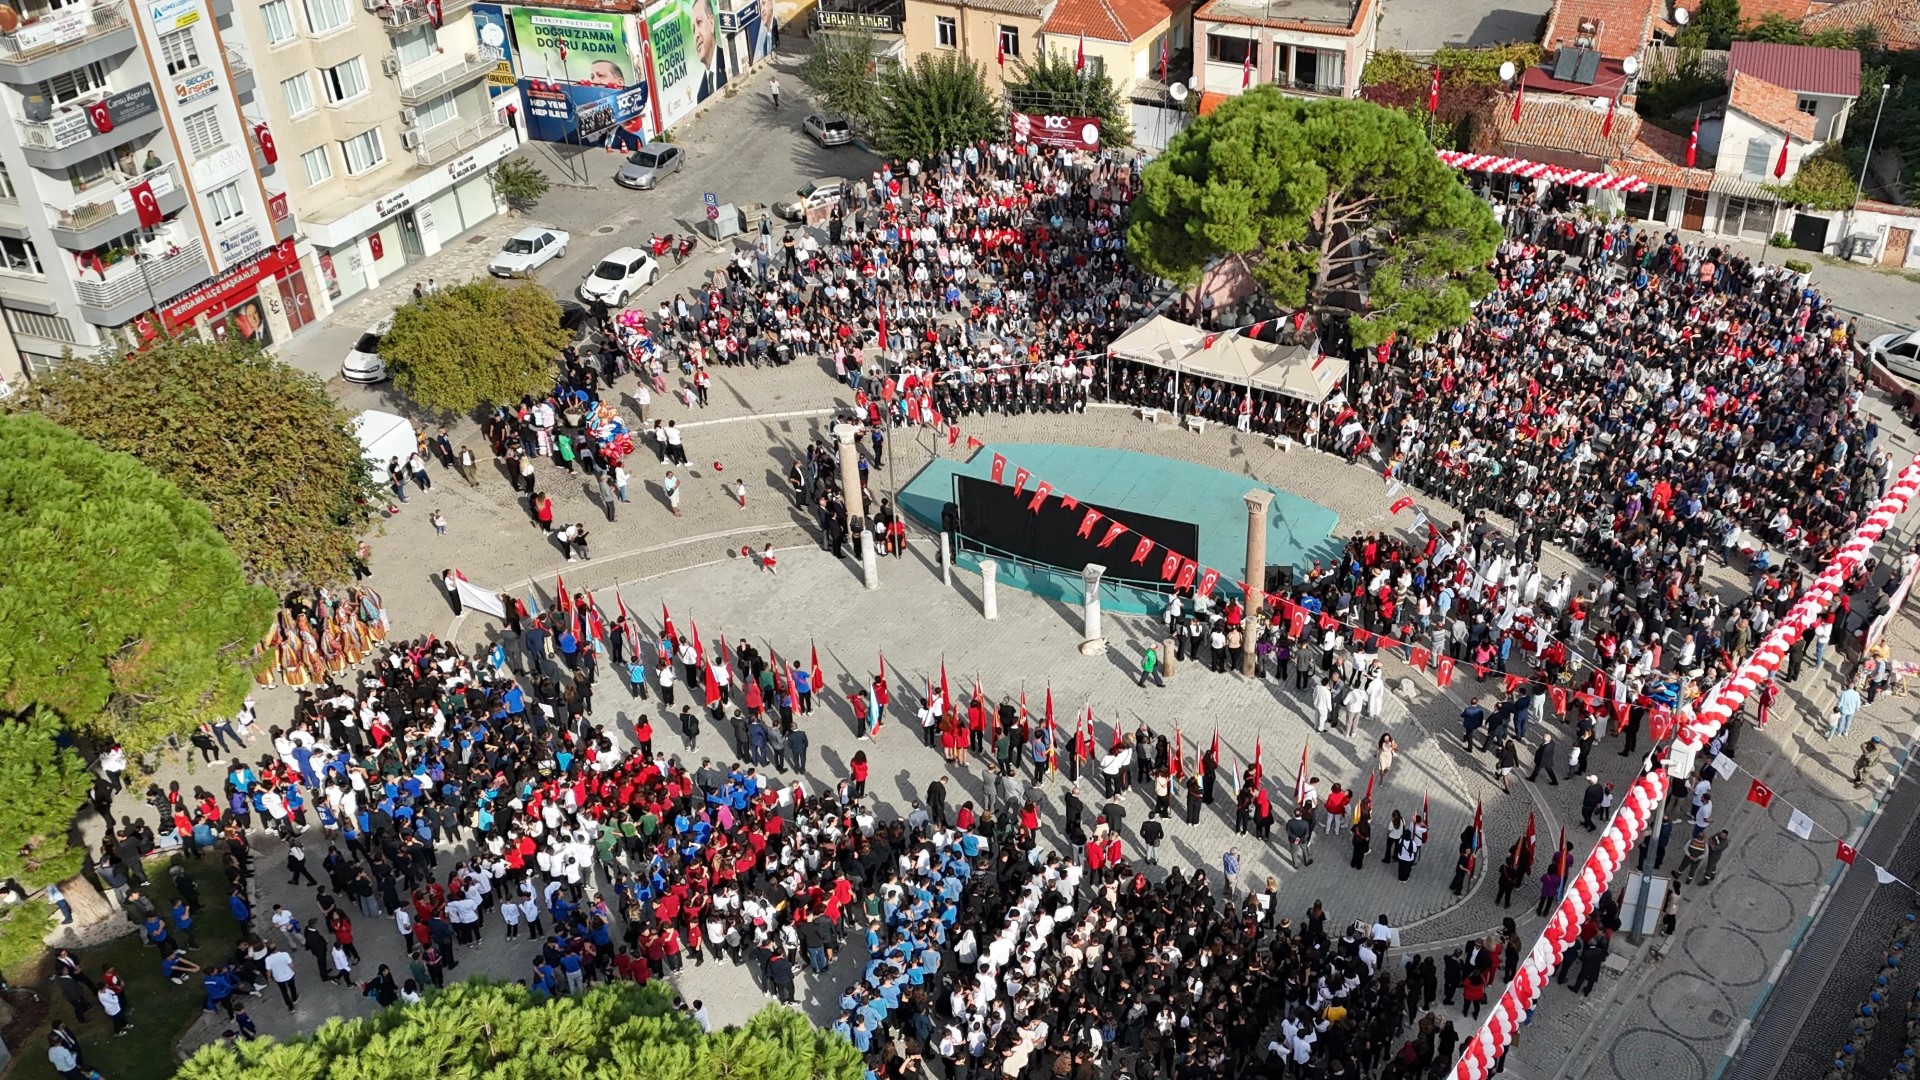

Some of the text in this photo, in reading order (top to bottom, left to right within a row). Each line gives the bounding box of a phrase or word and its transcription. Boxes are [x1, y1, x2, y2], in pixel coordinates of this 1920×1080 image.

[535, 25, 614, 42] DOĞRU ZAMAN
[653, 19, 681, 46] DOĞRU
[581, 41, 617, 54] ADAM
[656, 33, 683, 60] ZAMAN
[658, 48, 686, 76] DOĞRU
[662, 61, 688, 92] ADAM
[106, 96, 126, 110] Cansu
[126, 87, 150, 102] Köprülü
[530, 99, 547, 108] HEP
[531, 108, 549, 117] HEP
[241, 249, 272, 271] PARTİSİ
[172, 295, 207, 317] BERGAMA
[222, 266, 260, 292] BAŞKANLIĞI
